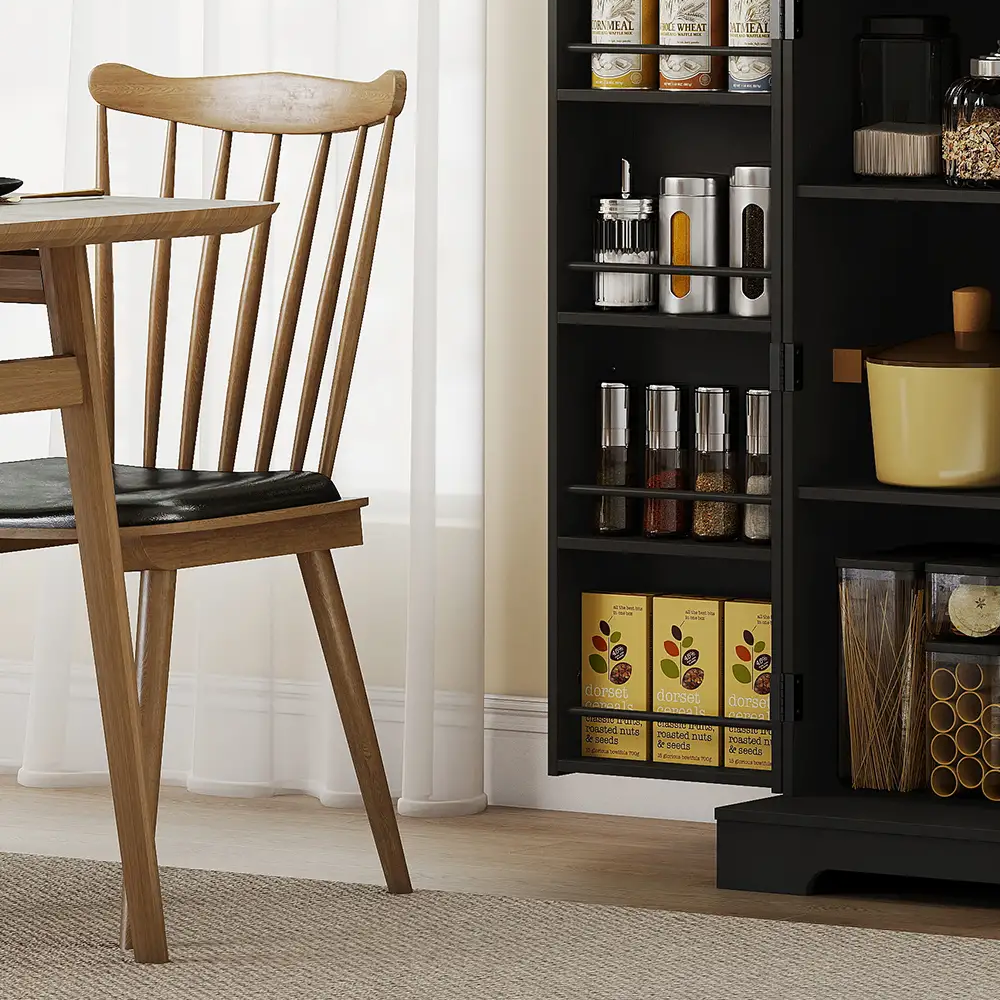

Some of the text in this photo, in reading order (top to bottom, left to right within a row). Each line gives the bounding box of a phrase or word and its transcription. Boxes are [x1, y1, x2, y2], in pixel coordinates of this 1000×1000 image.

[677, 23, 707, 32] WHEAT
[585, 683, 629, 699] dorset
[656, 688, 701, 704] dorset
[585, 725, 640, 736] roasted nuts
[657, 730, 712, 742] roasted nuts
[585, 735, 619, 745] & seeds
[657, 740, 691, 750] & seeds
[729, 736, 762, 745] roasted
[729, 745, 763, 756] & seeds
